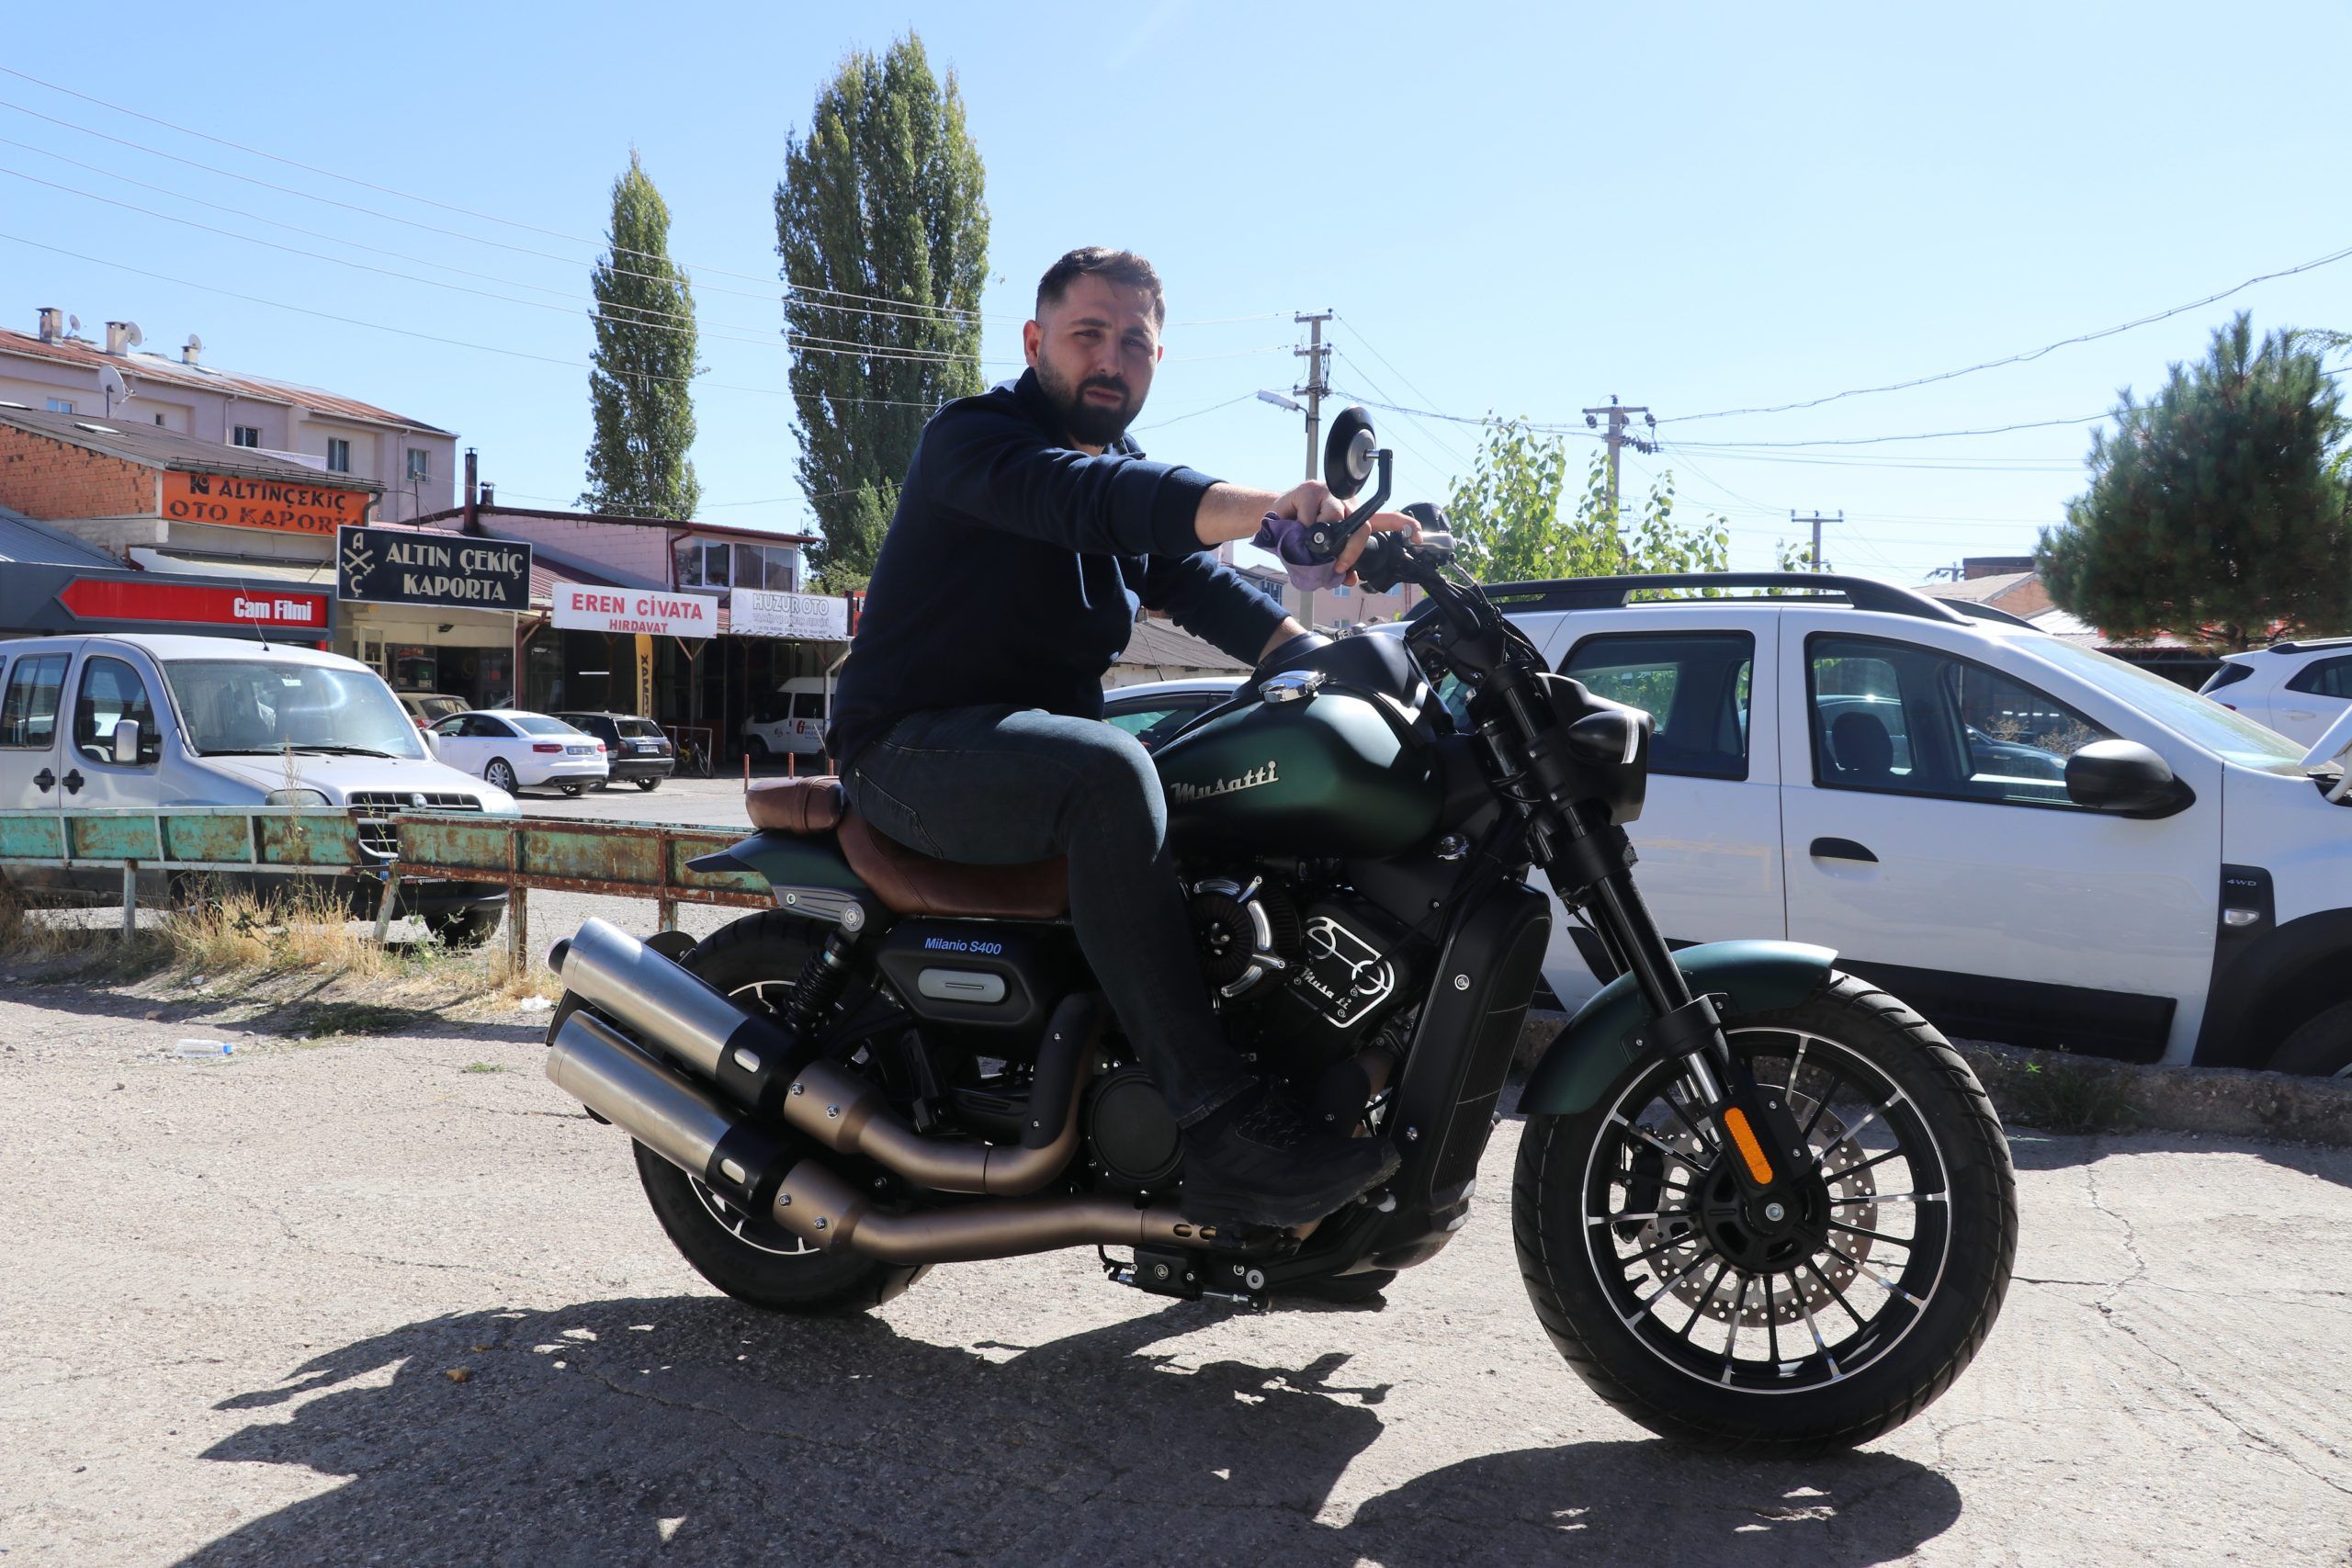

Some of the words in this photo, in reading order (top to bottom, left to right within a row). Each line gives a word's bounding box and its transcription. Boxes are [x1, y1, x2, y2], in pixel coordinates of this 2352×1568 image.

[219, 480, 345, 513] ALTINÇEKİÇ
[170, 500, 228, 521] OTO
[352, 533, 363, 549] A
[386, 543, 450, 568] ALTIN
[459, 548, 523, 579] ÇEKİÇ
[403, 574, 506, 601] KAPORTA
[234, 597, 270, 618] Cam
[274, 599, 311, 621] Filmi
[572, 592, 625, 614] EREN
[637, 595, 703, 620] CİVATA
[753, 593, 799, 615] HUZUR
[802, 597, 829, 615] OTO
[609, 619, 668, 633] HIRDAVAT
[1170, 760, 1279, 805] Musatti
[924, 937, 967, 952] Milanio
[969, 941, 1001, 954] S400
